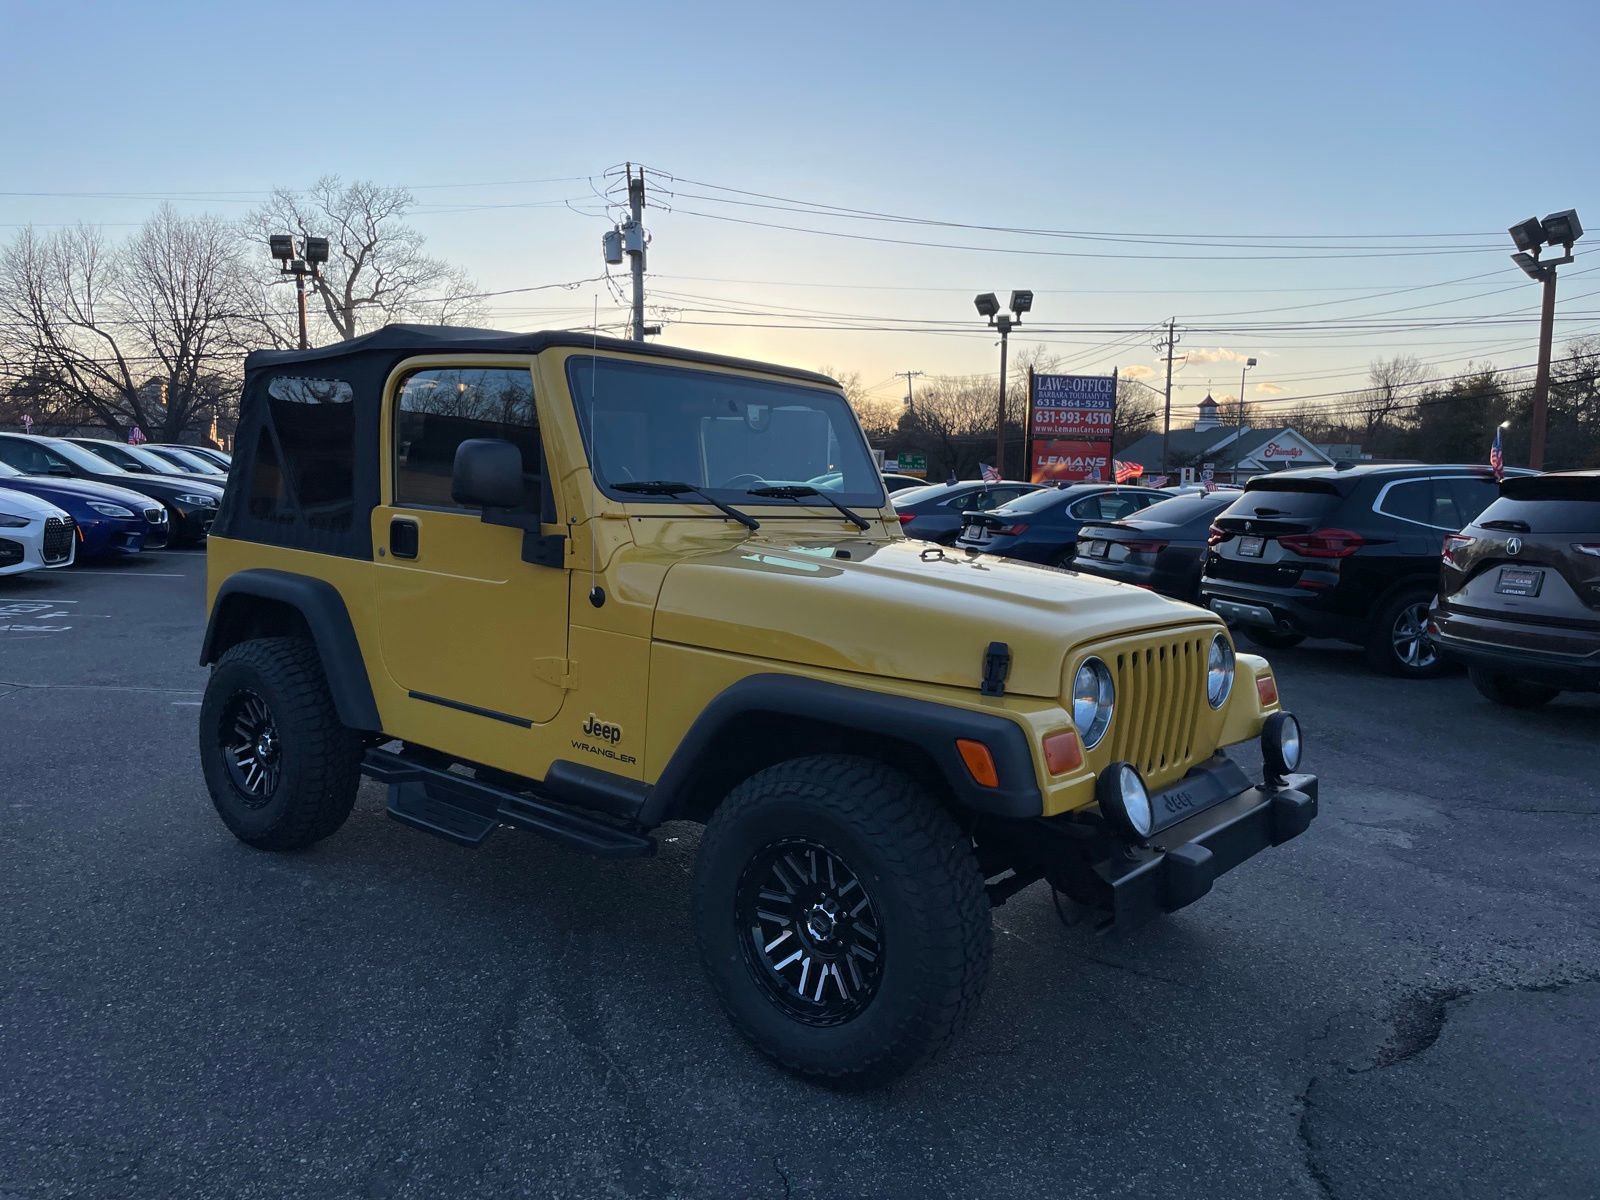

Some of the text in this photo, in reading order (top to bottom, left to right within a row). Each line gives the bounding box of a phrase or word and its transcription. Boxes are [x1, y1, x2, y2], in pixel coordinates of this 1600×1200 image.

[1038, 377, 1113, 393] LAW OFFICE
[1038, 390, 1068, 398] BARBARA
[1036, 398, 1111, 409] 631-864-5291
[1035, 410, 1112, 425] 631-993-4510
[1034, 425, 1110, 434] www.LemansCars.com
[1037, 455, 1107, 467] LEMANS
[582, 715, 622, 745] Jeep
[570, 739, 637, 765] WRANGLER
[1163, 790, 1195, 814] Jeep
